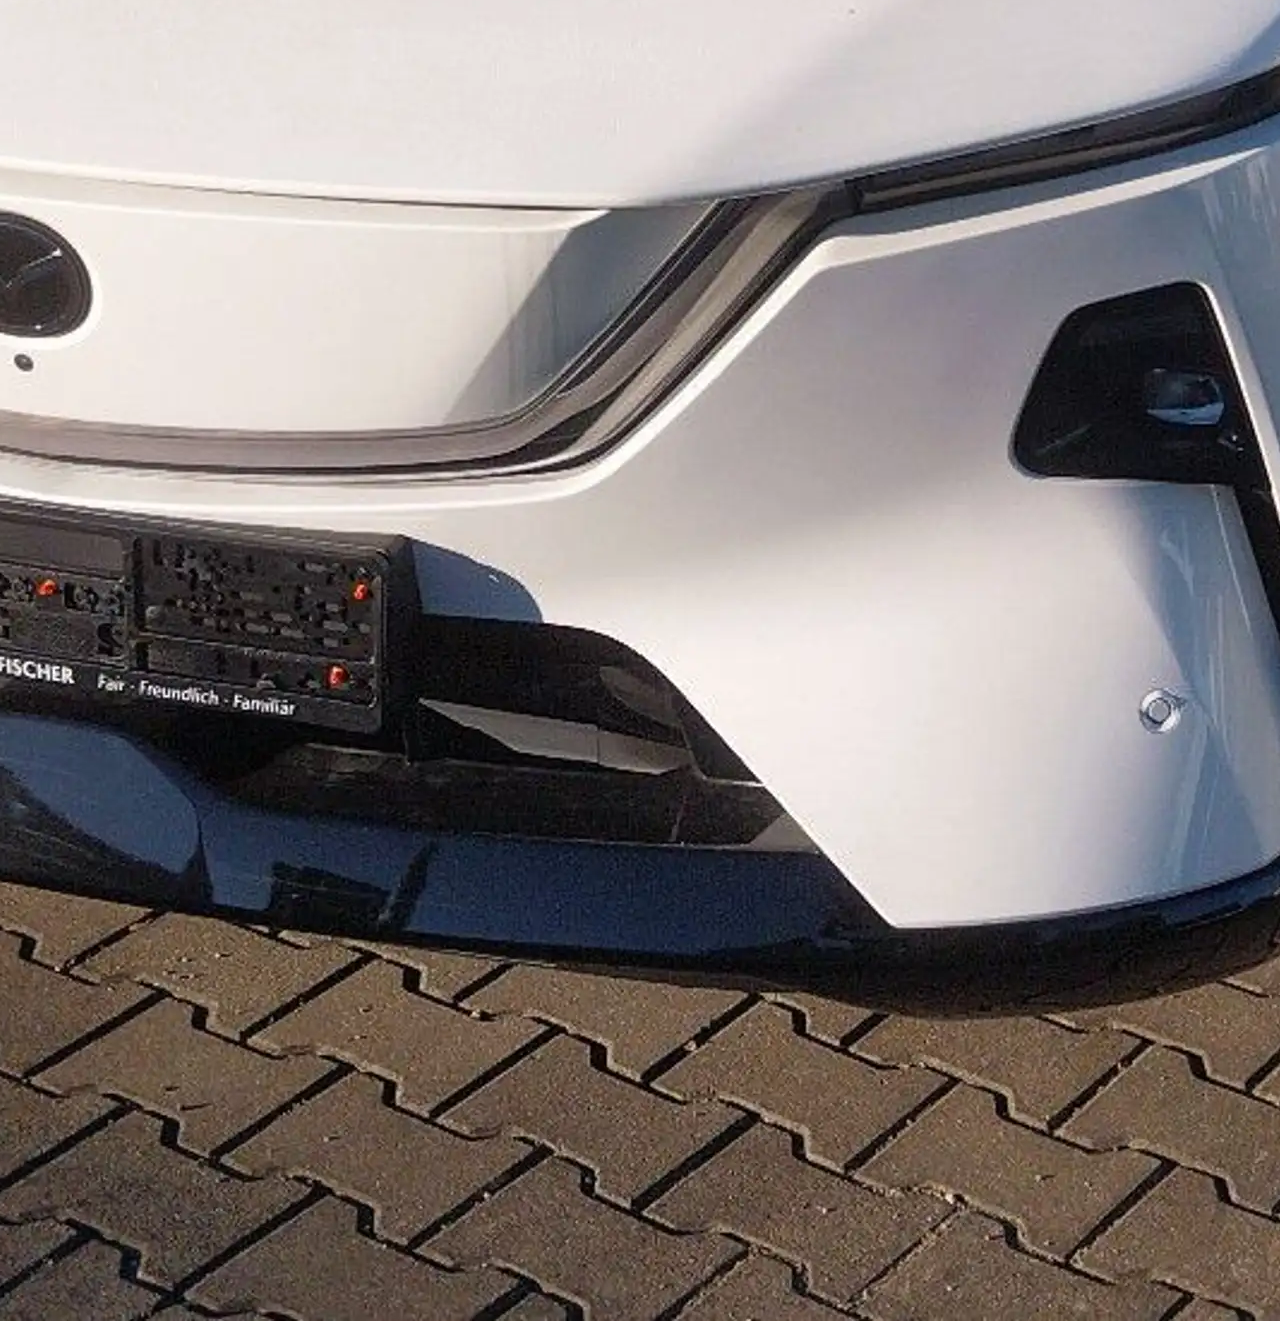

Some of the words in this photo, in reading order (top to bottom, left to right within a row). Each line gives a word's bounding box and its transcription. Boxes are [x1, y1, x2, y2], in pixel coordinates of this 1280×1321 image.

[98, 673, 125, 691] Fair
[139, 680, 219, 706] Freundlich
[232, 694, 296, 716] Familiär
